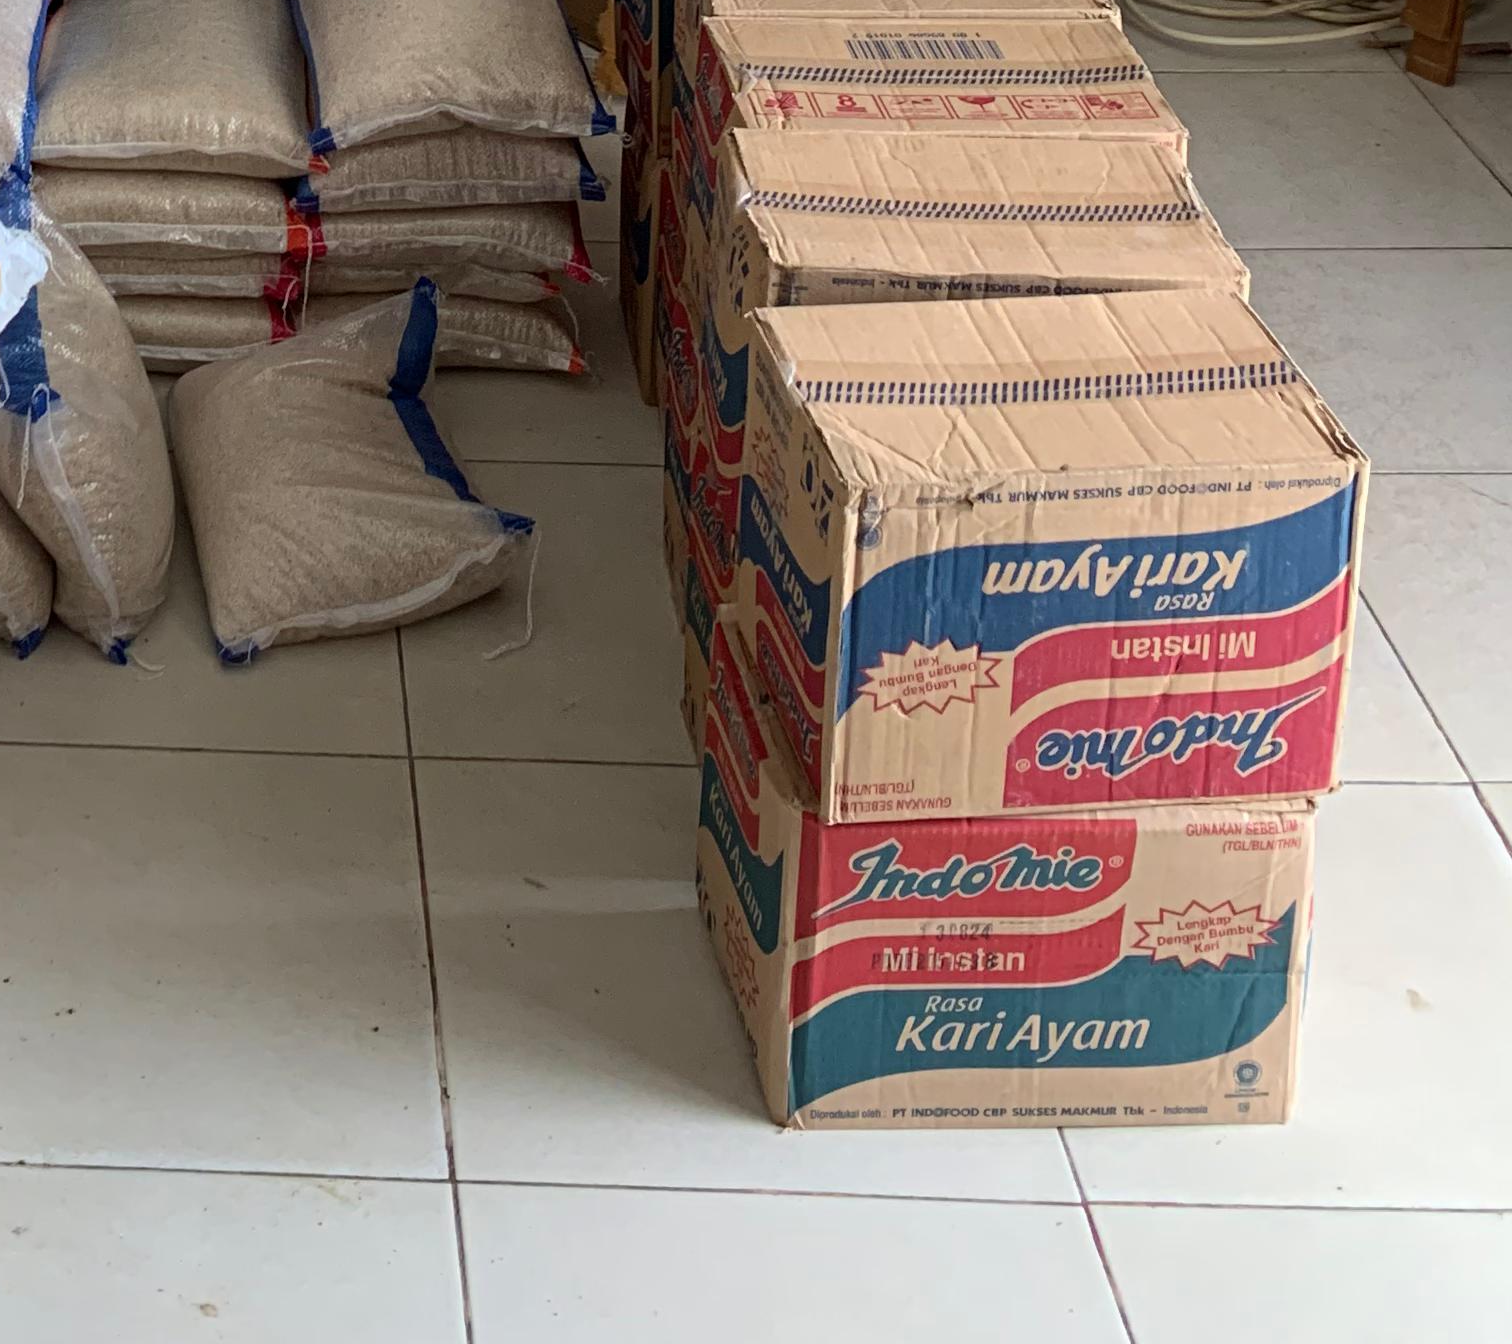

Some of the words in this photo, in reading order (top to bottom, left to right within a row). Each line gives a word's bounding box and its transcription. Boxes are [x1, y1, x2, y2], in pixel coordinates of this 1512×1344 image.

[916, 280, 972, 292] MAKMUR
[976, 283, 1021, 294] SUKSES
[1073, 487, 1123, 500] SUKSES
[1236, 481, 1253, 493] PT
[1009, 489, 1069, 502] MAKMUR
[982, 544, 1134, 597] Ayam
[1130, 549, 1246, 599] Kari
[1154, 592, 1214, 611] Rasa
[1111, 635, 1211, 662] Instan
[1219, 631, 1256, 658] Mi
[913, 656, 940, 669] Kari
[928, 663, 978, 678] Dengan
[879, 672, 924, 688] Bumbu
[902, 680, 957, 697] Lengkap
[896, 797, 952, 810] GUNAKAN
[1186, 821, 1242, 837] GUNAKAN
[729, 846, 763, 932] Ayam
[1177, 916, 1232, 932] Lengkap
[1209, 925, 1254, 939] Bumbu
[1157, 931, 1205, 947] Dengan
[1194, 942, 1219, 953] Kari
[882, 947, 918, 972] Mi
[927, 947, 1025, 972] Instan
[925, 996, 983, 1012] Rasa
[896, 1012, 1006, 1052] Kari
[1007, 1014, 1150, 1063] Ayam
[892, 1108, 907, 1119] PT
[910, 1106, 980, 1119] INDOFOOD
[1012, 1106, 1057, 1118] SUKSES
[1060, 1105, 1117, 1117] MAKMUR
